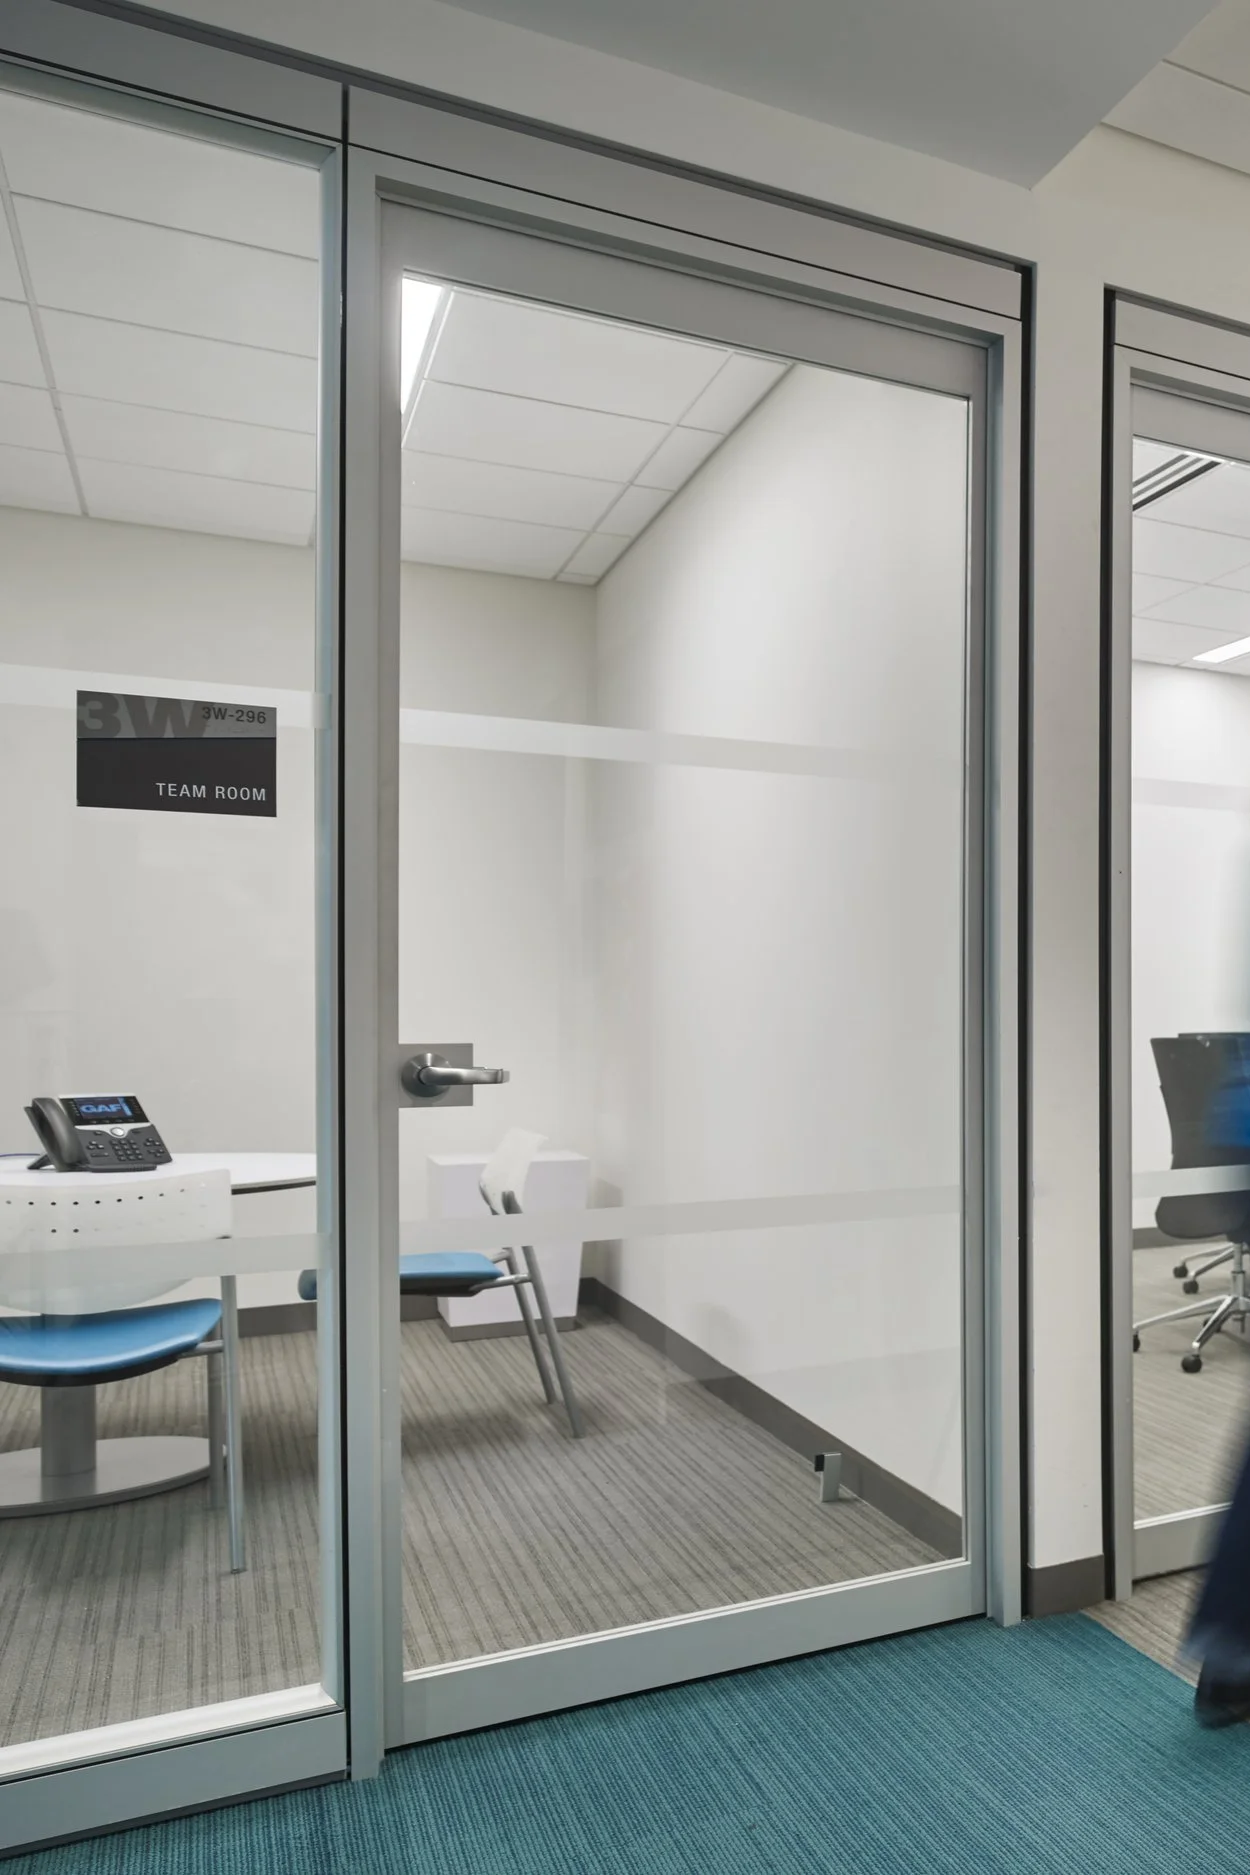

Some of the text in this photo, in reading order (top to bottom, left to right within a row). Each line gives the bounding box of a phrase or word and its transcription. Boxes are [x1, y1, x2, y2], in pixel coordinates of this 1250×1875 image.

[202, 706, 266, 724] 3W-296
[156, 782, 266, 801] TEAM ROOM
[80, 1104, 121, 1113] GAF
